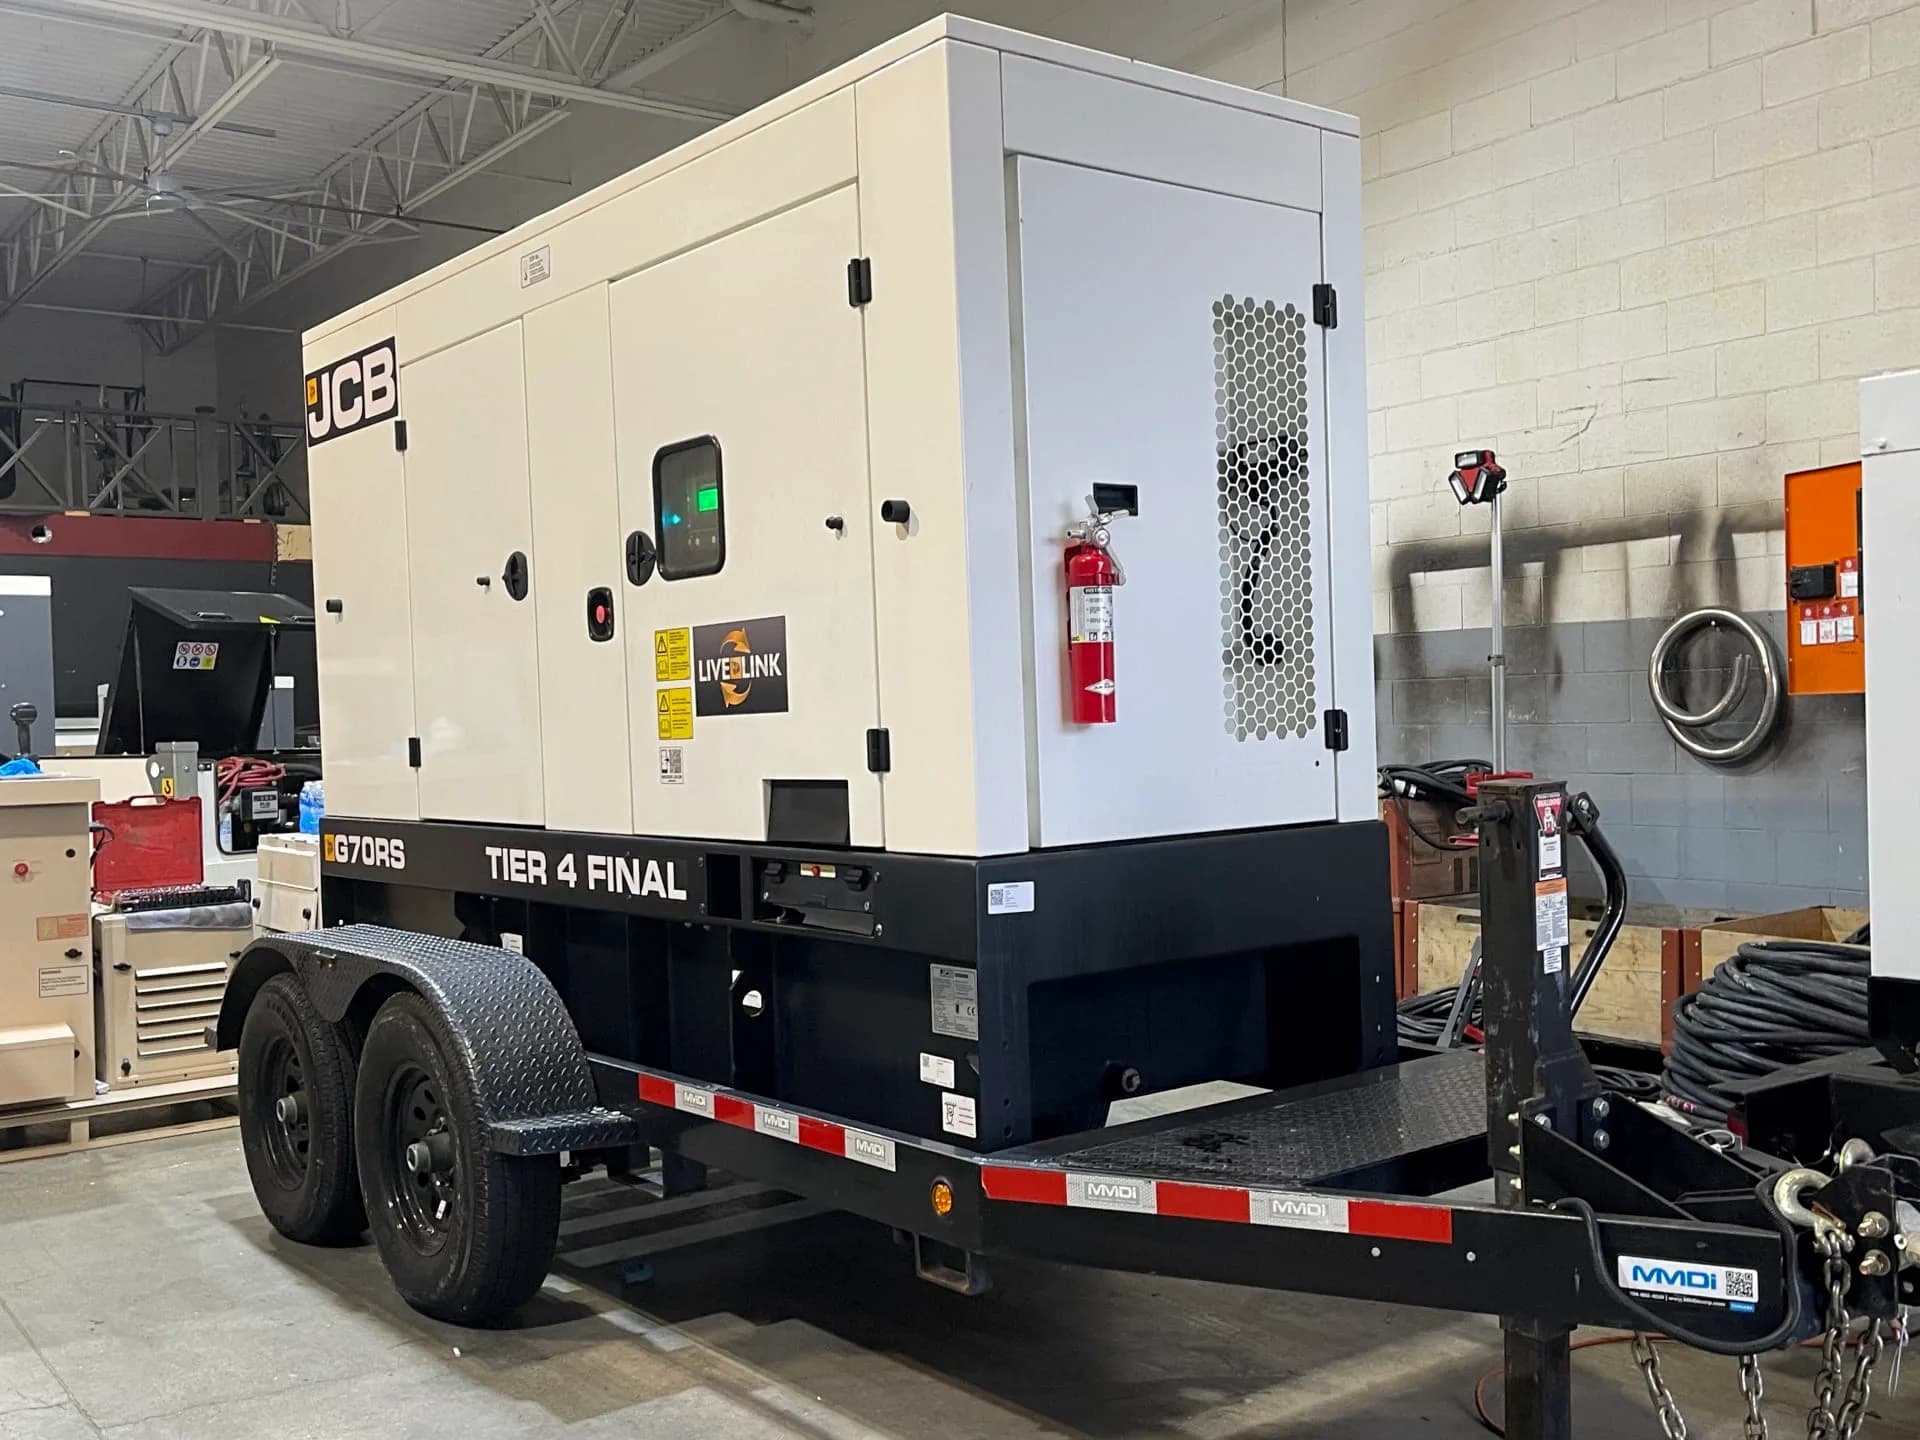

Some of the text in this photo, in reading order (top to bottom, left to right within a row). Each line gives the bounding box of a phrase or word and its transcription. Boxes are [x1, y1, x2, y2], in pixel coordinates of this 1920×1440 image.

[308, 347, 396, 439] JCB
[698, 652, 782, 683] LIVE LINK
[335, 834, 406, 870] G70RS
[485, 846, 687, 901] TIER 4 FINAL
[1632, 1265, 1717, 1290] MMDi
